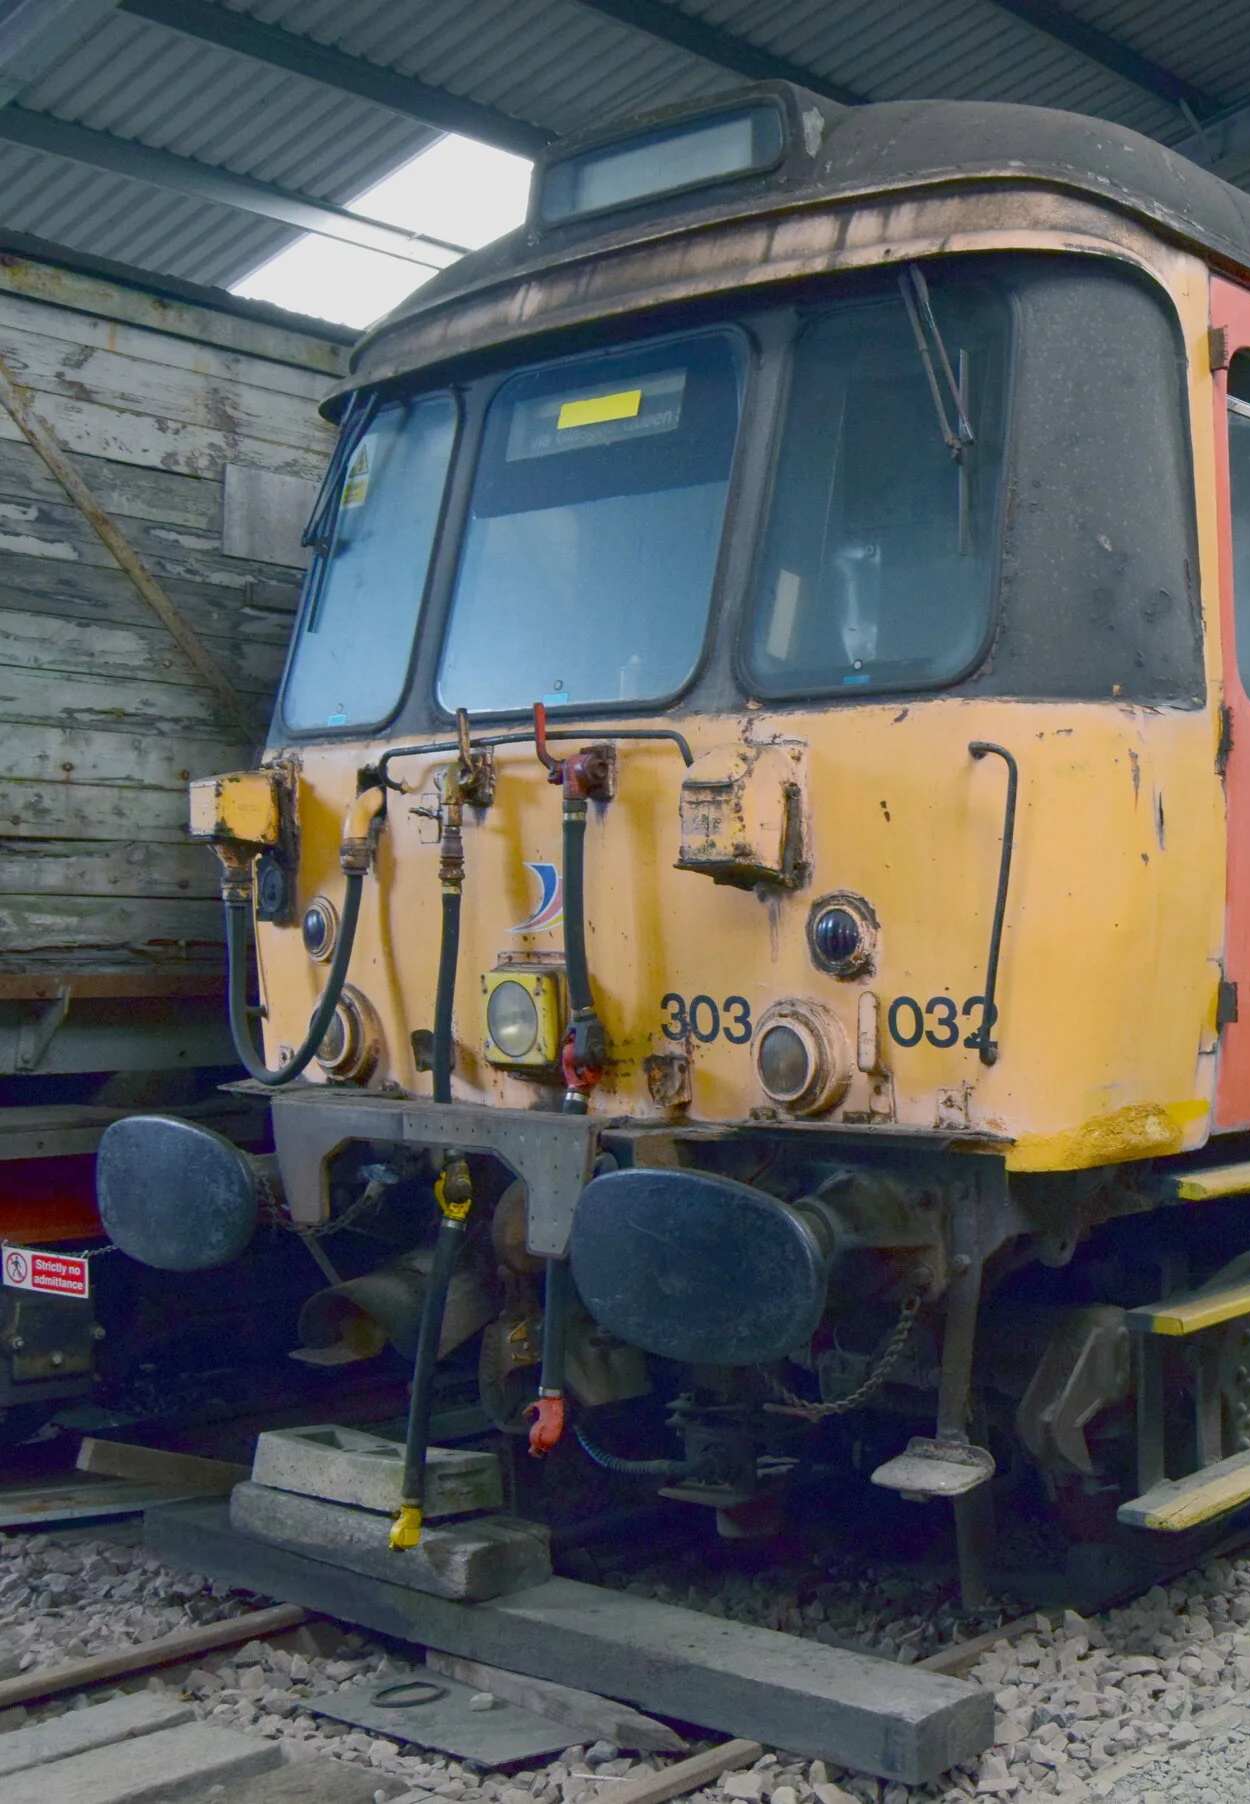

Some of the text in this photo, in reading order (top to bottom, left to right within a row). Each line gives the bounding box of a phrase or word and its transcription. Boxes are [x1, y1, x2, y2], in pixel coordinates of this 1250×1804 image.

[660, 993, 999, 1049] 303 032
[35, 1259, 81, 1276] Strictly no
[34, 1274, 83, 1290] admittance
